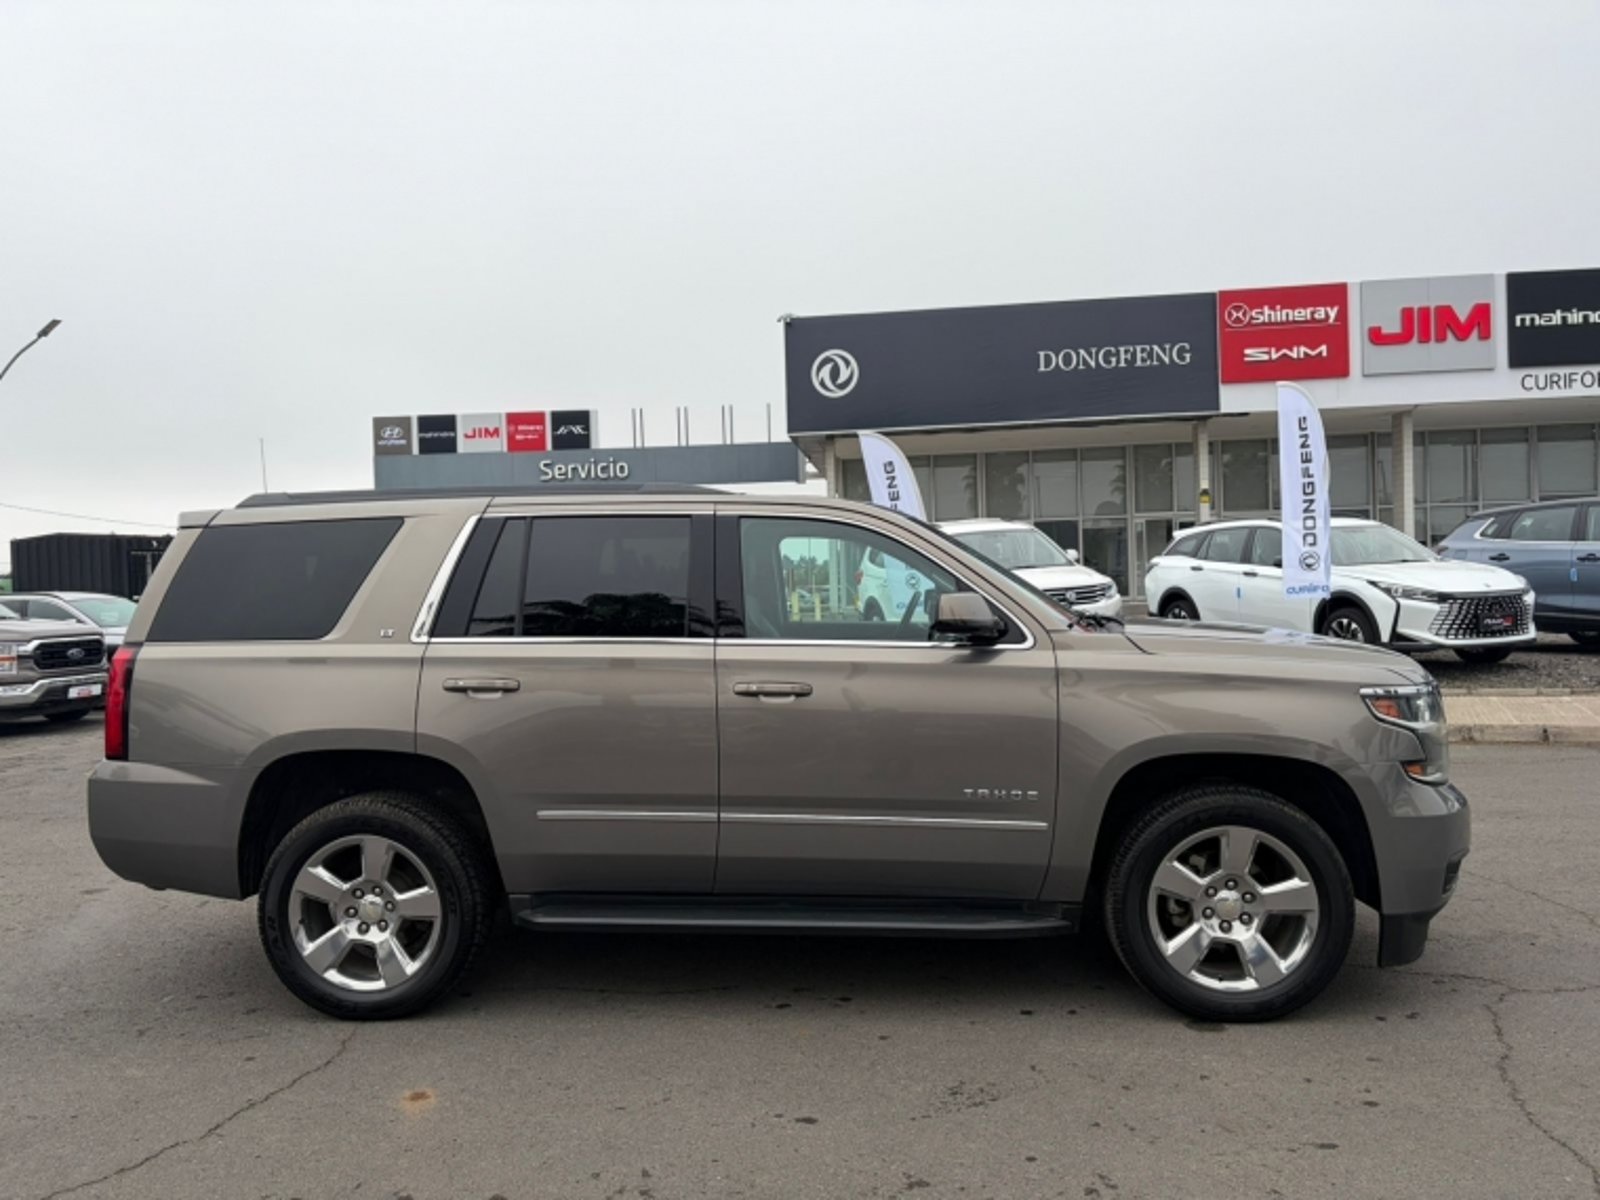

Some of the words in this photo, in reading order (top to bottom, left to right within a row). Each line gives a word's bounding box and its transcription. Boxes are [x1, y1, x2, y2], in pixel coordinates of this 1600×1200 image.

[1251, 304, 1339, 324] shineray
[1368, 302, 1491, 346] JIM
[1037, 342, 1192, 372] DONGFENG
[1243, 344, 1328, 362] SWM
[1521, 370, 1600, 391] CURIFO
[463, 426, 500, 440] JIM
[539, 457, 629, 481] Servicio
[1298, 416, 1317, 547] DONGFENG
